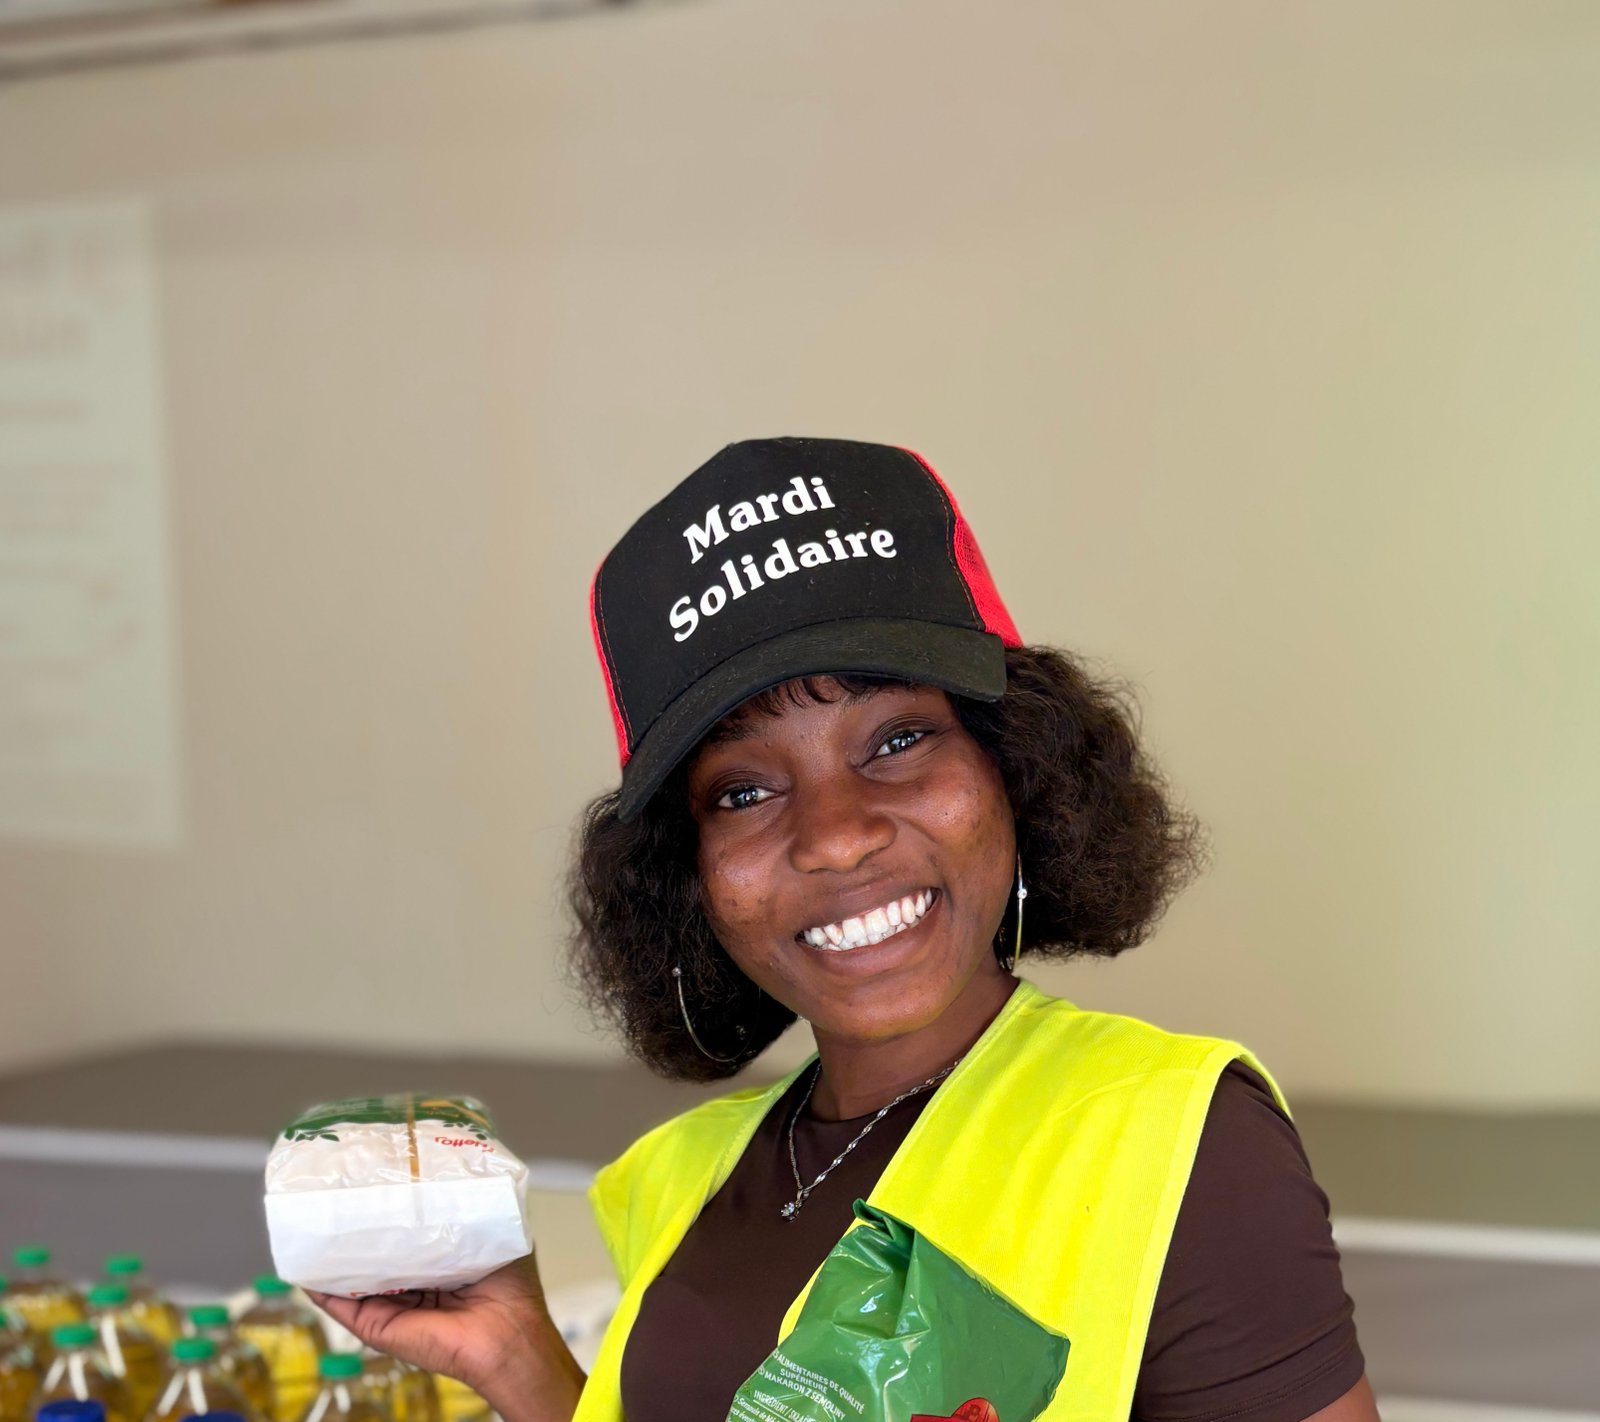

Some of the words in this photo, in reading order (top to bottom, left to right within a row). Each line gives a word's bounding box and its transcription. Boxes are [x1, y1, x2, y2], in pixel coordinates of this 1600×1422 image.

[683, 476, 836, 564] Mardi
[669, 529, 897, 642] Solidaire
[765, 1372, 804, 1393] MAKARON
[804, 1389, 810, 1397] Z
[810, 1392, 845, 1420] SEMOLINY
[777, 1354, 828, 1385] ALIMENTAIRES
[830, 1381, 839, 1392] DE
[839, 1388, 864, 1414] QUALITÉ
[780, 1369, 827, 1393] SUPÉRIEURE
